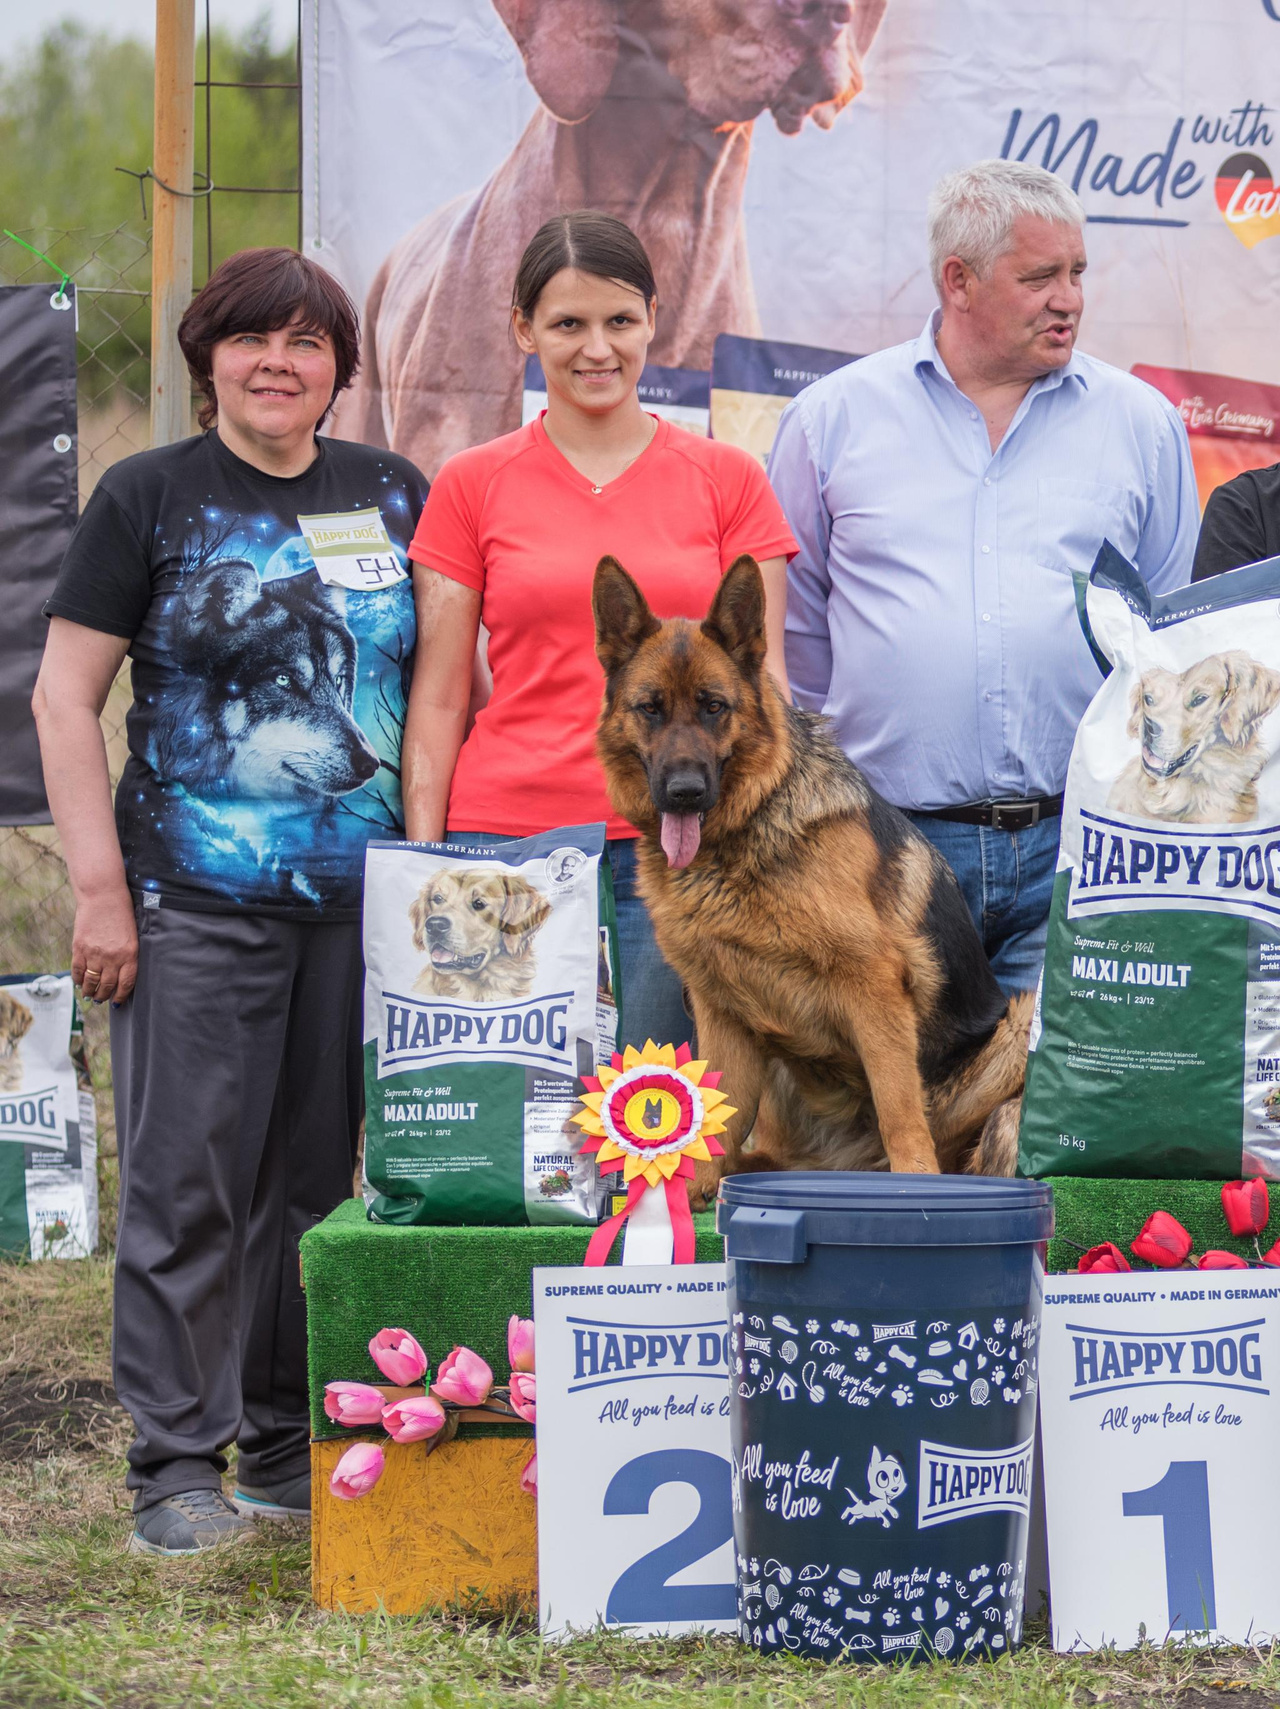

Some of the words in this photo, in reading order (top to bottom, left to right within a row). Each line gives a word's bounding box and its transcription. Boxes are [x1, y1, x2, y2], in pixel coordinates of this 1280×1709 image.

[1000, 109, 1206, 207] Made
[1192, 100, 1274, 147] with
[1215, 403, 1275, 437] Germany
[312, 529, 351, 543] HAPPY
[353, 526, 379, 540] DOG
[356, 556, 402, 584] 54
[1155, 604, 1212, 624] GERMANY
[447, 844, 496, 856] GERMANY
[1078, 825, 1211, 889] HAPPY
[1074, 935, 1105, 950] Supreme
[1106, 940, 1119, 950] Fit
[1121, 941, 1133, 953] &
[1134, 942, 1156, 953] Well
[1260, 943, 1270, 951] Mit
[1072, 956, 1118, 982] MAXI
[1122, 962, 1192, 987] ADULT
[1134, 996, 1154, 1005] 23/12
[386, 1004, 496, 1054] HAPPY
[499, 1005, 567, 1052] DOG
[1256, 1072, 1274, 1082] LIFE
[384, 1088, 411, 1100] Supreme
[412, 1087, 423, 1096] Fit
[424, 1087, 433, 1097] &
[434, 1086, 451, 1096] Well
[0, 1097, 56, 1129] DOG
[384, 1104, 422, 1122] MAXI
[425, 1103, 478, 1120] ADULT
[1059, 1134, 1069, 1146] 15
[1072, 1136, 1086, 1151] kg
[534, 1156, 574, 1165] NATURAL
[547, 1164, 574, 1172] CONCEPT
[545, 1285, 603, 1297] SUPREME
[606, 1283, 662, 1295] QUALITY
[677, 1282, 713, 1292] MADE
[716, 1282, 727, 1291] IN
[1044, 1293, 1100, 1305] SUPREME
[1103, 1292, 1156, 1303] QUALITY
[1170, 1290, 1205, 1301] MADE
[1208, 1289, 1221, 1300] IN
[873, 1325, 899, 1340] HAPPY
[899, 1324, 915, 1337] CAT
[573, 1329, 692, 1380] HAPPY
[1072, 1336, 1186, 1387] HAPPY
[1191, 1332, 1262, 1381] DOG
[822, 1362, 841, 1381] All
[842, 1372, 862, 1387] you
[861, 1376, 885, 1399] feed
[847, 1387, 870, 1407] love
[599, 1398, 629, 1423] All
[632, 1406, 661, 1426] you
[664, 1394, 698, 1420] feed
[701, 1402, 714, 1416] is
[1100, 1406, 1128, 1431] All
[1132, 1413, 1159, 1434] you
[1162, 1403, 1194, 1428] feed
[1197, 1410, 1210, 1425] is
[1214, 1404, 1242, 1426] love
[741, 1443, 762, 1482] All
[765, 1460, 792, 1488] you
[794, 1450, 840, 1490] feed
[927, 1459, 1007, 1508] HAPPY
[1007, 1453, 1030, 1498] DOG
[766, 1492, 777, 1512] is
[782, 1483, 821, 1520] love
[603, 1448, 737, 1623] 2
[1122, 1460, 1217, 1631] 1
[873, 1569, 891, 1590] All
[892, 1573, 910, 1588] you
[910, 1567, 932, 1584] feed
[894, 1589, 902, 1600] is
[903, 1586, 925, 1601] love
[790, 1602, 809, 1621] All
[805, 1613, 822, 1630] you
[820, 1618, 844, 1640] feed
[810, 1628, 831, 1648] love
[883, 1635, 906, 1649] HAPPY
[907, 1633, 921, 1646] CAT
